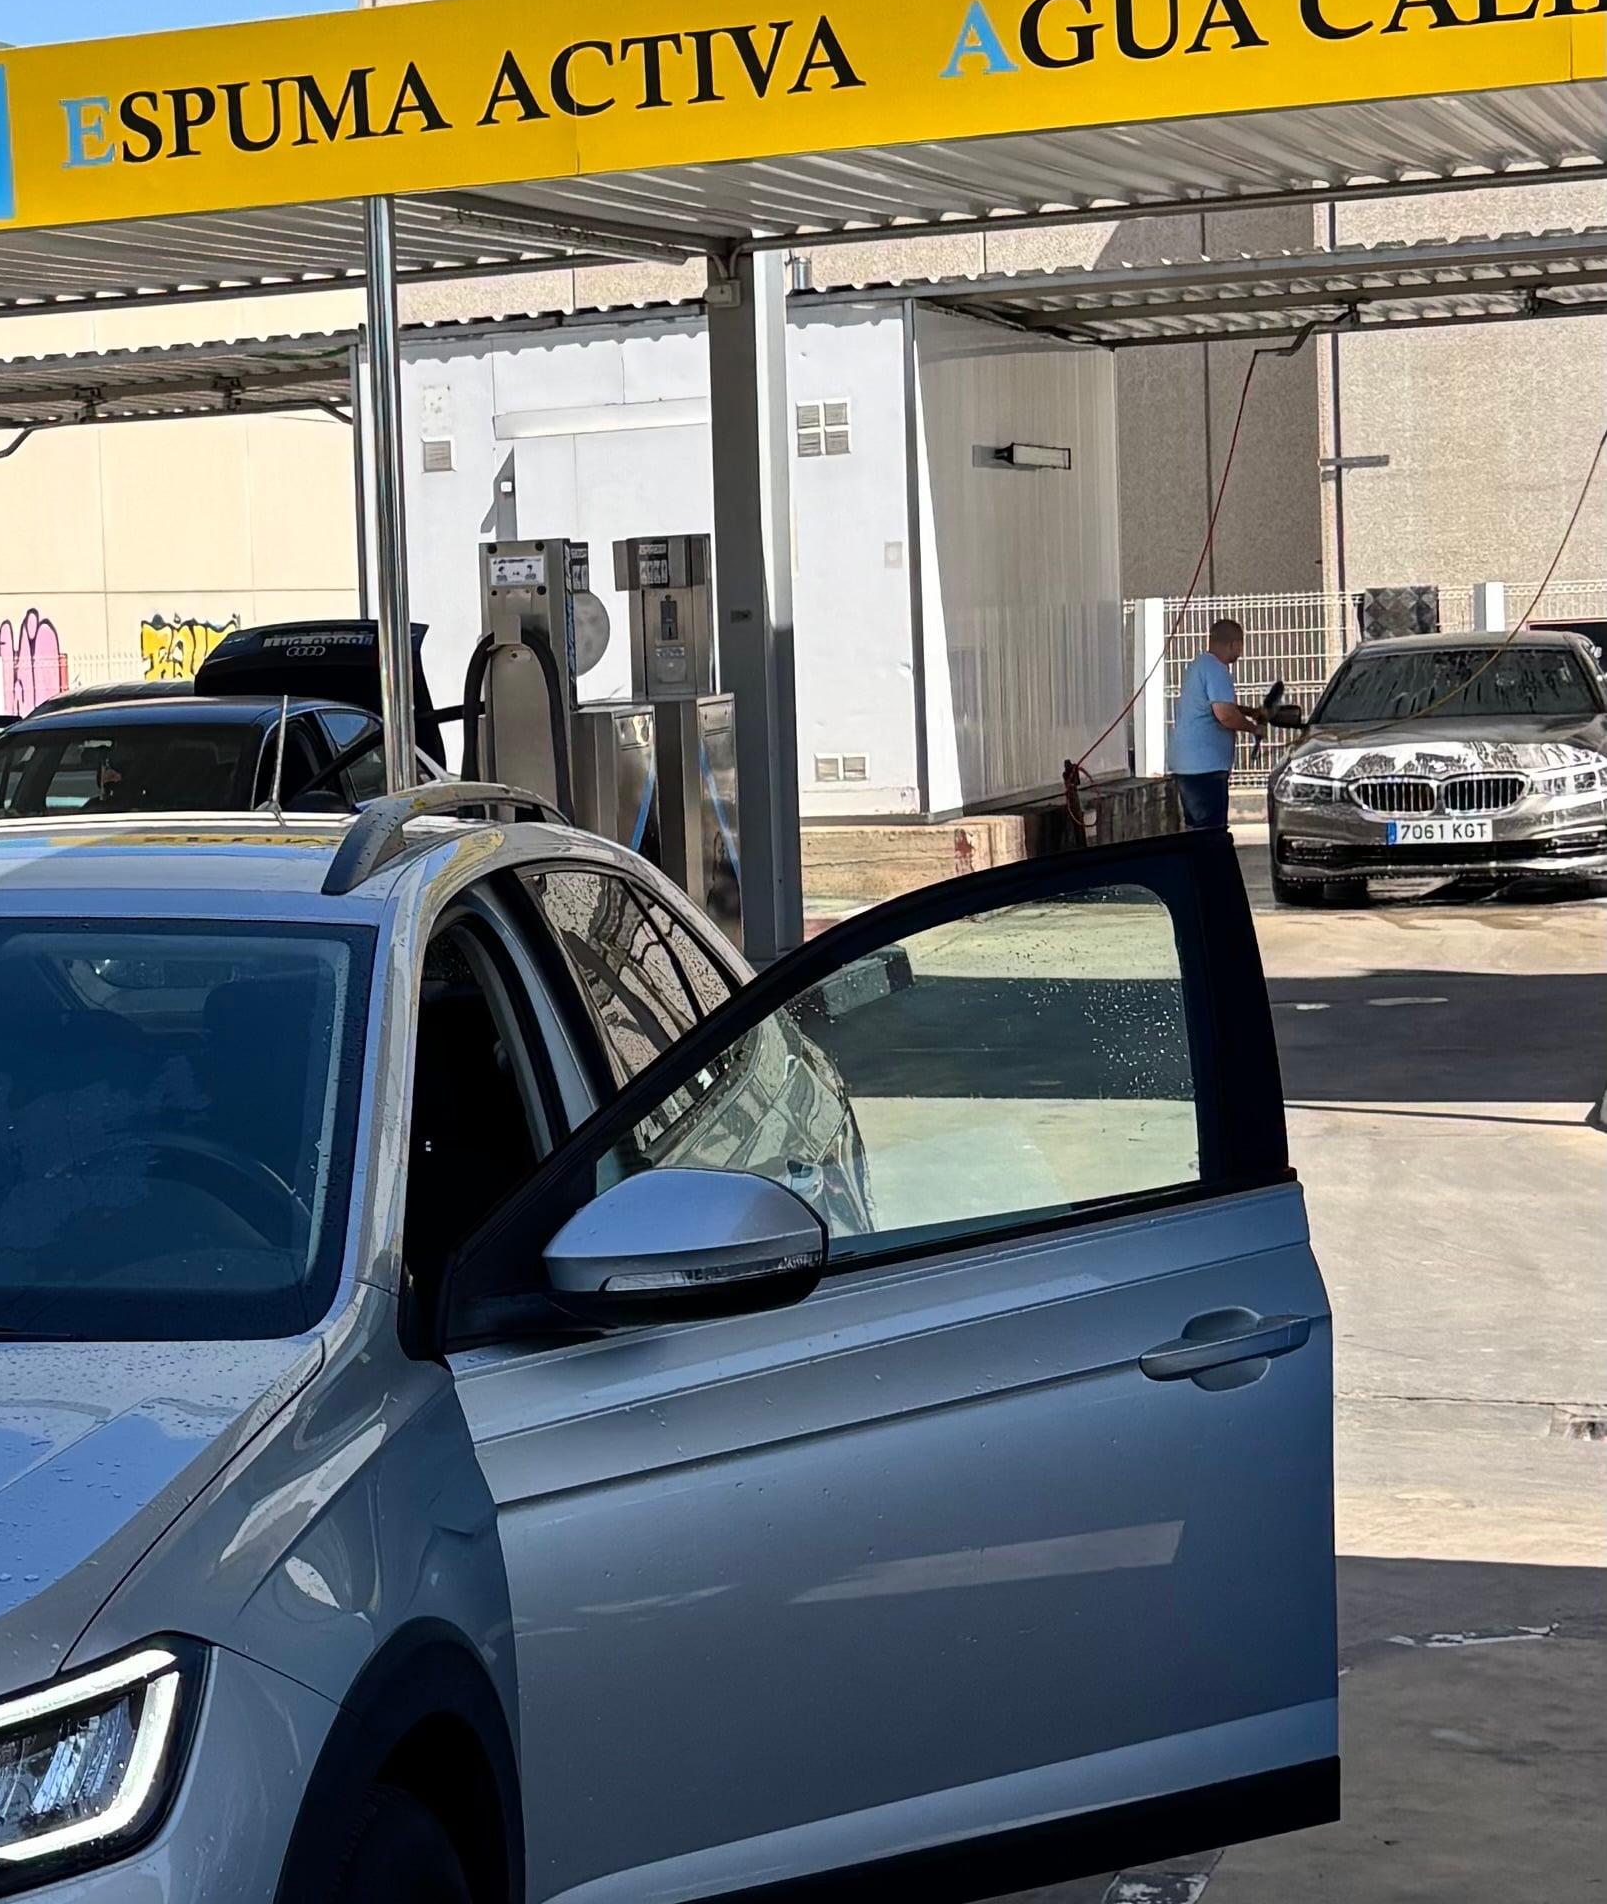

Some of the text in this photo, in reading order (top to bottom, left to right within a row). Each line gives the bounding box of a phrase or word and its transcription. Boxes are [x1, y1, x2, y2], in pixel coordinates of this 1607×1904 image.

[59, 14, 867, 171] ESPUMA ACTIVA
[1401, 823, 1487, 840] 7061 KGT
